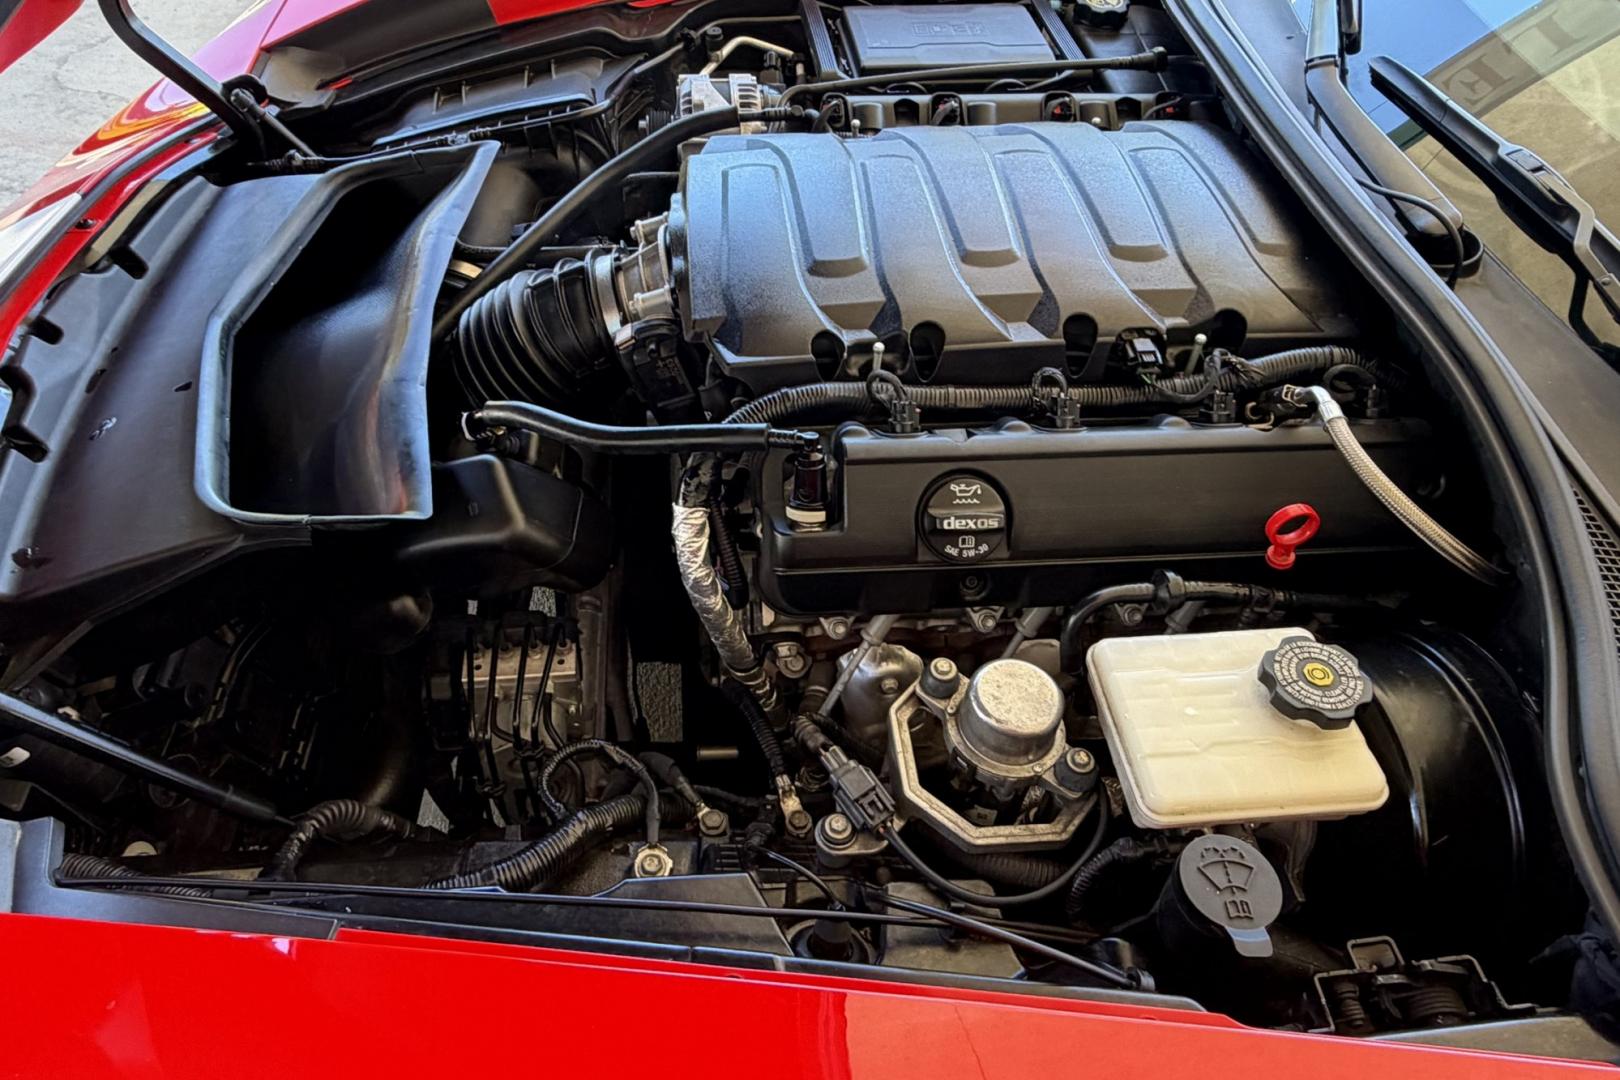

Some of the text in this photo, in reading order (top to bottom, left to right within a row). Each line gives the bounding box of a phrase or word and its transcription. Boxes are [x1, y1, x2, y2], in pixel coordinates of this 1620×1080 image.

[943, 516, 999, 530] dexos
[944, 543, 988, 558] SAE 5W-30
